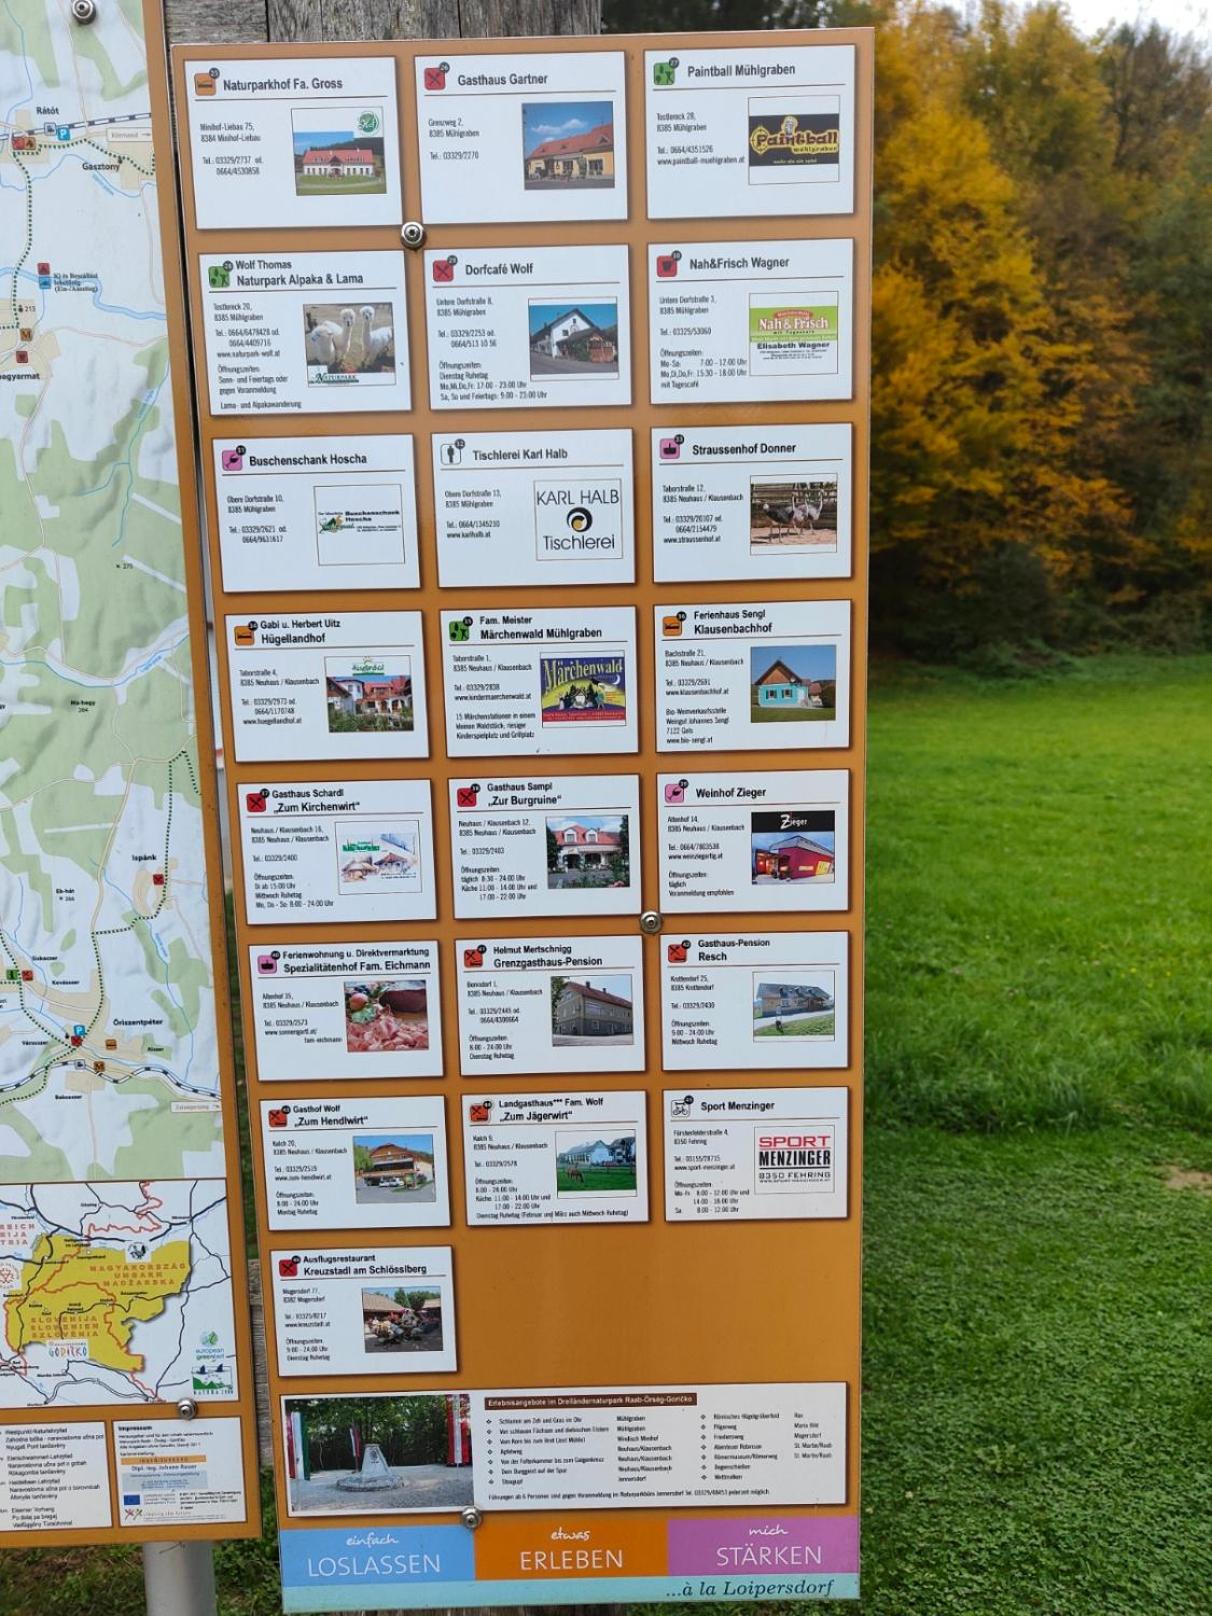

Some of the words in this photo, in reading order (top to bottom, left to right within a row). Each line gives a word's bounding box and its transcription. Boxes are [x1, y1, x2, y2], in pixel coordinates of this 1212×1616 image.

[688, 65, 732, 77] Paintball
[735, 64, 795, 78] Mühlgraben
[224, 78, 290, 93] Naturparkhof
[293, 78, 309, 90] Fa.
[312, 77, 344, 89] Gross
[458, 74, 506, 86] Gasthaus
[509, 73, 548, 84] Gartner
[36, 106, 59, 115] Rátót
[756, 132, 838, 147] Paintball
[82, 162, 120, 173] Gasztony
[236, 260, 255, 270] Wolf
[257, 260, 292, 270] Thomas
[465, 263, 508, 275] Dorfcafé
[510, 263, 534, 274] Wolf
[690, 258, 748, 270] Nah&Frisch
[751, 257, 790, 270] Wagner
[237, 275, 286, 288] Naturpark
[288, 274, 323, 287] Alpaka
[326, 274, 333, 284] &
[336, 273, 363, 284] Lama
[759, 318, 782, 330] Nah
[794, 316, 828, 330] Frisch
[472, 450, 520, 460] Tischlerei
[523, 448, 542, 459] Karl
[546, 448, 568, 459] Halb
[692, 443, 758, 456] Straussenhof
[760, 443, 796, 454] Donner
[250, 454, 328, 466] Buschenschank
[330, 453, 367, 464] Hoscha
[537, 490, 574, 505] KARL
[580, 489, 620, 504] HALB
[543, 534, 614, 550] Tischlerei
[480, 616, 500, 625] Fam.
[502, 616, 532, 624] Meister
[694, 611, 740, 620] Ferienhaus
[742, 609, 765, 620] Sengl
[260, 620, 280, 629] Gabi
[292, 620, 323, 628] Herbert
[324, 619, 341, 628] Uitz
[694, 622, 772, 635] Klausenbachhof
[262, 632, 326, 646] Hügellandhof
[480, 629, 543, 640] Märchenwald
[546, 627, 602, 640] Mühlgraben
[543, 658, 623, 687] Märchenwald
[272, 790, 311, 798] Gasthaus
[312, 788, 344, 797] Schardl
[487, 784, 525, 792] Gasthaus
[528, 782, 552, 792] Sampl
[696, 787, 735, 798] Weinhof
[736, 787, 766, 800] Zieger
[488, 796, 508, 807] „Zur
[511, 794, 562, 807] Burgruine“
[274, 803, 299, 814] „Zum
[302, 801, 360, 812] Kirchenwirt“
[780, 814, 807, 830] Zieger
[493, 946, 522, 954] Helmut
[523, 945, 572, 954] Mertschnigg
[698, 939, 770, 947] Gasthaus-Pension
[283, 951, 344, 960] Ferienwohnung
[356, 948, 429, 957] Direktvermarktung
[698, 952, 727, 961] Resch
[284, 962, 358, 975] Spezialitätenhof
[360, 962, 382, 971] Fam.
[385, 961, 430, 970] Eichmann
[494, 957, 603, 969] Grenzgasthaus-Pension
[293, 1105, 322, 1113] Gasthof
[324, 1104, 340, 1112] Wolf
[565, 1098, 583, 1106] Fam.
[586, 1098, 604, 1106] Wolf
[701, 1102, 726, 1112] Sport
[728, 1101, 775, 1112] Menzinger
[294, 1117, 318, 1128] „Zum
[500, 1112, 524, 1122] „Zum
[759, 1136, 831, 1147] SPORT
[759, 1150, 830, 1166] MENZINGER
[788, 1171, 831, 1179] FEHRING
[304, 1254, 376, 1264] Ausflugsrestaurant
[304, 1266, 350, 1276] Kreuzstadl
[551, 1529, 590, 1542] etwas
[749, 1523, 789, 1537] mich
[346, 1532, 399, 1547] einfach
[520, 1549, 623, 1571] ERLEBEN
[716, 1544, 822, 1566] STÄRKEN
[307, 1554, 441, 1577] LOSLASSEN
[700, 1582, 717, 1597] la
[723, 1578, 833, 1600] Loipersdorf
